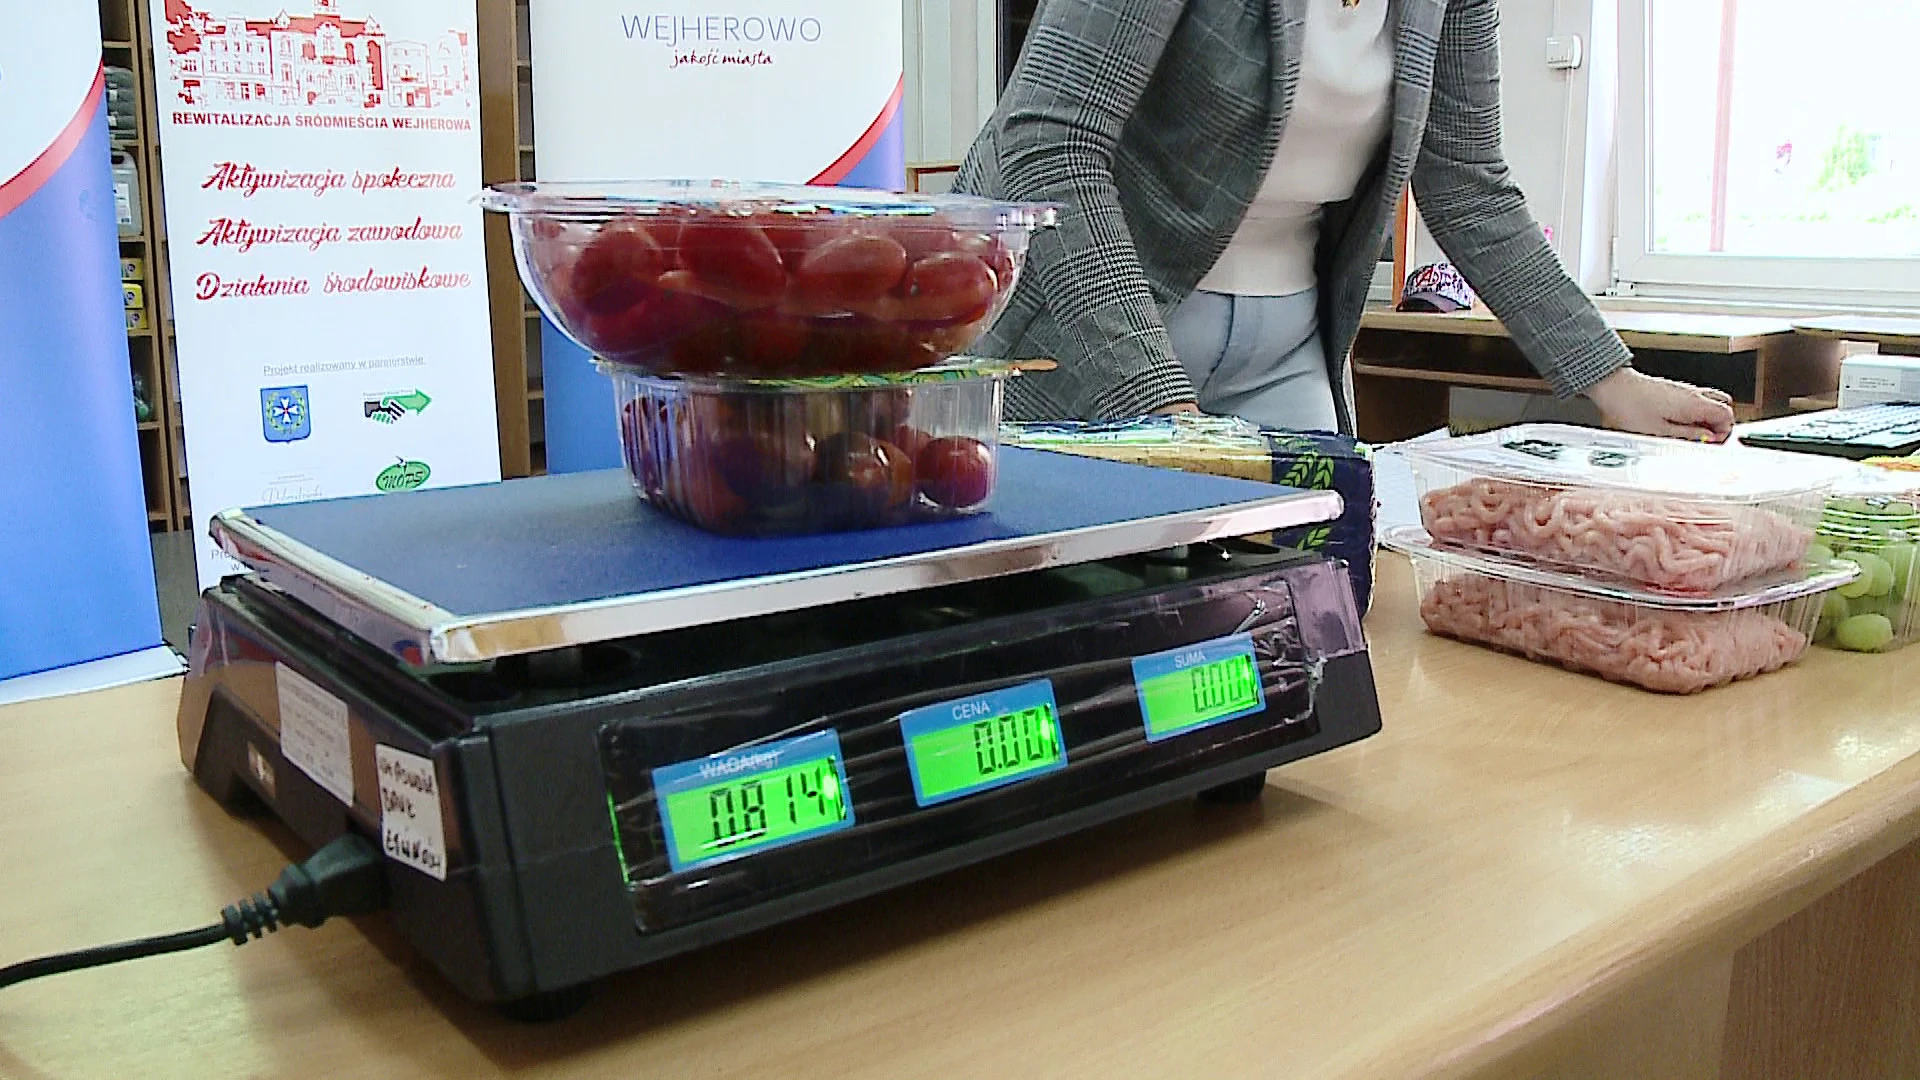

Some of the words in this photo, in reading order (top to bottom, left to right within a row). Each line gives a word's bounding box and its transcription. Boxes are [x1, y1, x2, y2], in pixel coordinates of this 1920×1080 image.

[621, 15, 821, 47] WEJHEROWO
[669, 48, 719, 69] jakość
[721, 49, 773, 66] miasta
[172, 112, 291, 127] REWITALIZACJA
[295, 112, 389, 129] ŚRÓDMIEŚCIA
[392, 117, 471, 130] WEJHEROWA
[201, 161, 346, 198] Aktywizacja
[351, 166, 456, 194] społeczna
[196, 218, 341, 253] Aktywizacja
[347, 216, 463, 242] zawodowa
[196, 272, 310, 300] Działania
[323, 266, 471, 293] środowiskowe
[263, 364, 298, 376] Projekt
[300, 360, 355, 374] realizowany
[358, 360, 365, 369] w
[1174, 650, 1206, 668] SUMA
[952, 700, 991, 720] CENA
[974, 709, 1044, 774] 0.00
